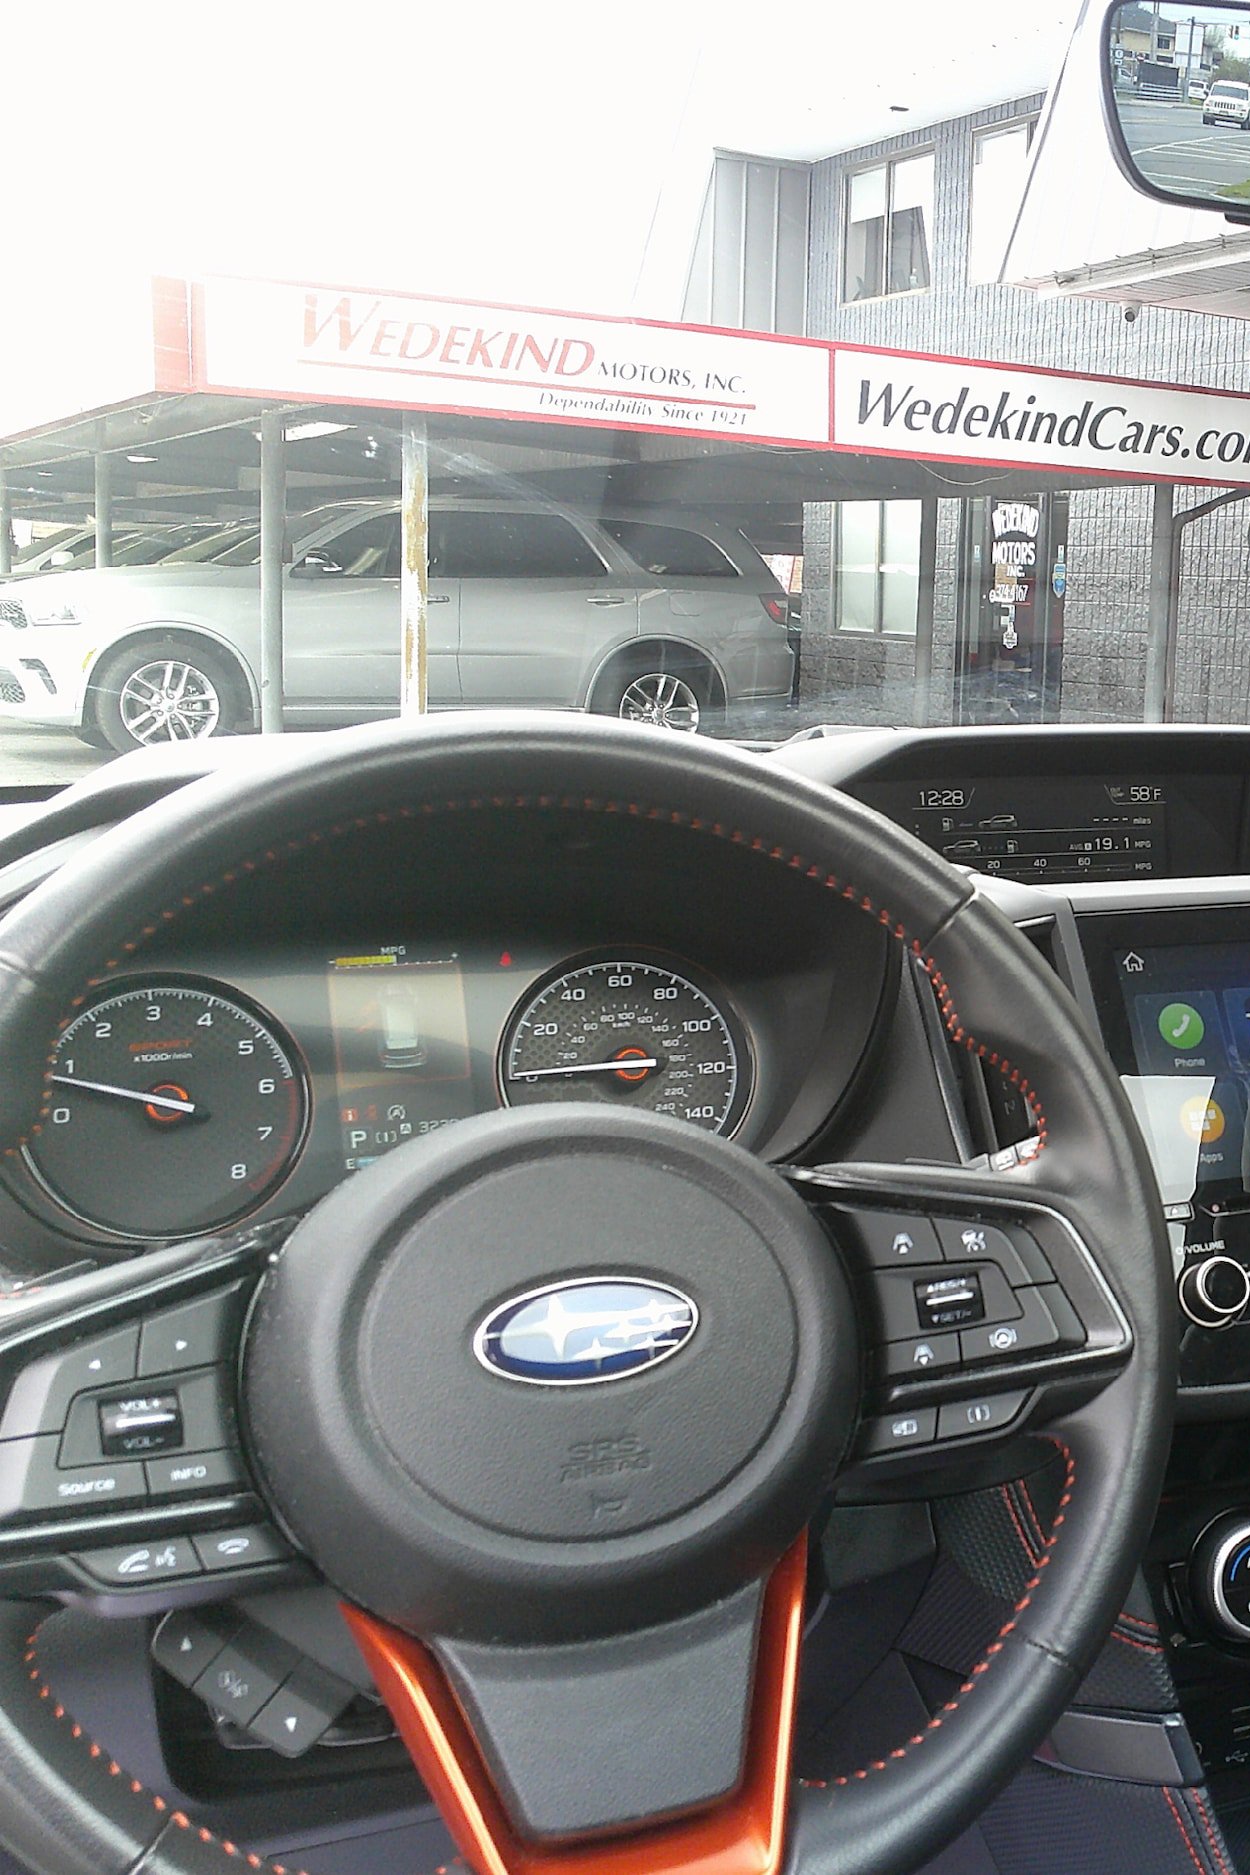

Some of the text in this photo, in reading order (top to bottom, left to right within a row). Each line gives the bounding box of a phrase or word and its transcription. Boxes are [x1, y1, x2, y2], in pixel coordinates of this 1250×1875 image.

[303, 295, 746, 393] WEDEKIND MOTORS, INC.
[539, 392, 747, 425] Dependability Since 1921
[992, 503, 1039, 538] WEDEKIND
[992, 542, 1036, 565] MOTORS
[1006, 565, 1025, 577] INC.
[920, 790, 964, 806] 12:28
[1095, 837, 1130, 851] 19.1
[1134, 841, 1152, 849] MPG
[987, 860, 1001, 869] 20
[1033, 858, 1047, 867] 40
[1077, 857, 1091, 866] 60
[380, 946, 406, 955] MPG
[608, 975, 632, 987] 60
[561, 988, 586, 1001] 40
[653, 987, 678, 1000] 80
[146, 1006, 161, 1021] 3
[197, 1013, 214, 1027] 4
[617, 1012, 636, 1021] 100
[637, 1015, 653, 1024] 120
[95, 1023, 112, 1038] 2
[533, 1022, 559, 1036] 20
[583, 1022, 598, 1031] 60
[651, 1024, 670, 1033] 140
[682, 1019, 712, 1033] 100
[570, 1035, 586, 1044] 40
[662, 1039, 680, 1048] 160
[238, 1041, 254, 1055] 5
[563, 1051, 578, 1060] 20
[669, 1054, 686, 1062] 180
[1174, 1056, 1205, 1068] Phone
[65, 1060, 75, 1073] 1
[697, 1061, 726, 1074] 120
[669, 1070, 688, 1079] 200
[258, 1079, 275, 1094] 6
[664, 1087, 684, 1096] 220
[53, 1109, 70, 1124] 0
[684, 1106, 714, 1119] 140
[258, 1126, 273, 1141] 7
[351, 1131, 367, 1149] P
[346, 1158, 355, 1169] E
[1200, 1153, 1224, 1164] Apps
[231, 1164, 247, 1179] 8
[170, 1466, 207, 1481] INFO
[58, 1478, 116, 1497] Source
